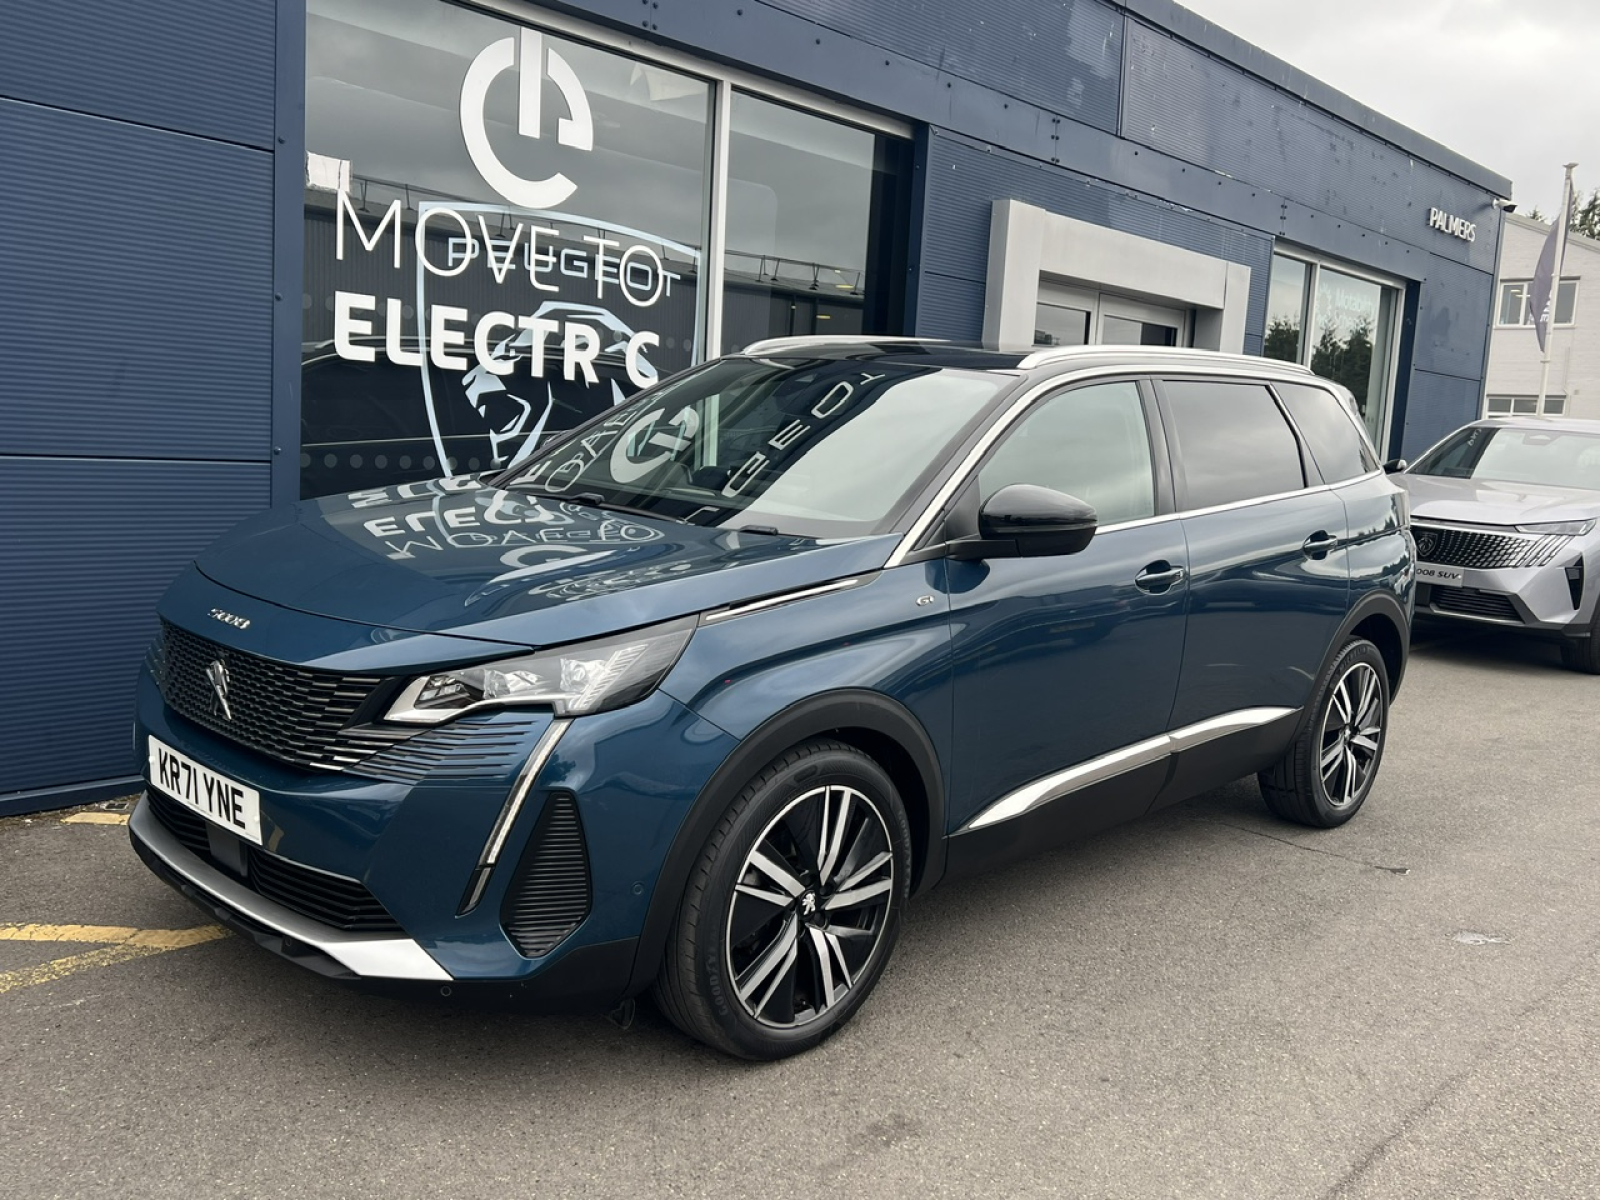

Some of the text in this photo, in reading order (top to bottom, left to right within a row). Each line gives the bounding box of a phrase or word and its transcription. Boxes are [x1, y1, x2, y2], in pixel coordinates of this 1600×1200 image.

[336, 189, 663, 307] MOVE TO
[1429, 207, 1476, 242] PALMERS
[448, 237, 681, 297] PEUGEOT
[1436, 570, 1460, 580] SUV
[159, 747, 246, 829] KR71 YNE
